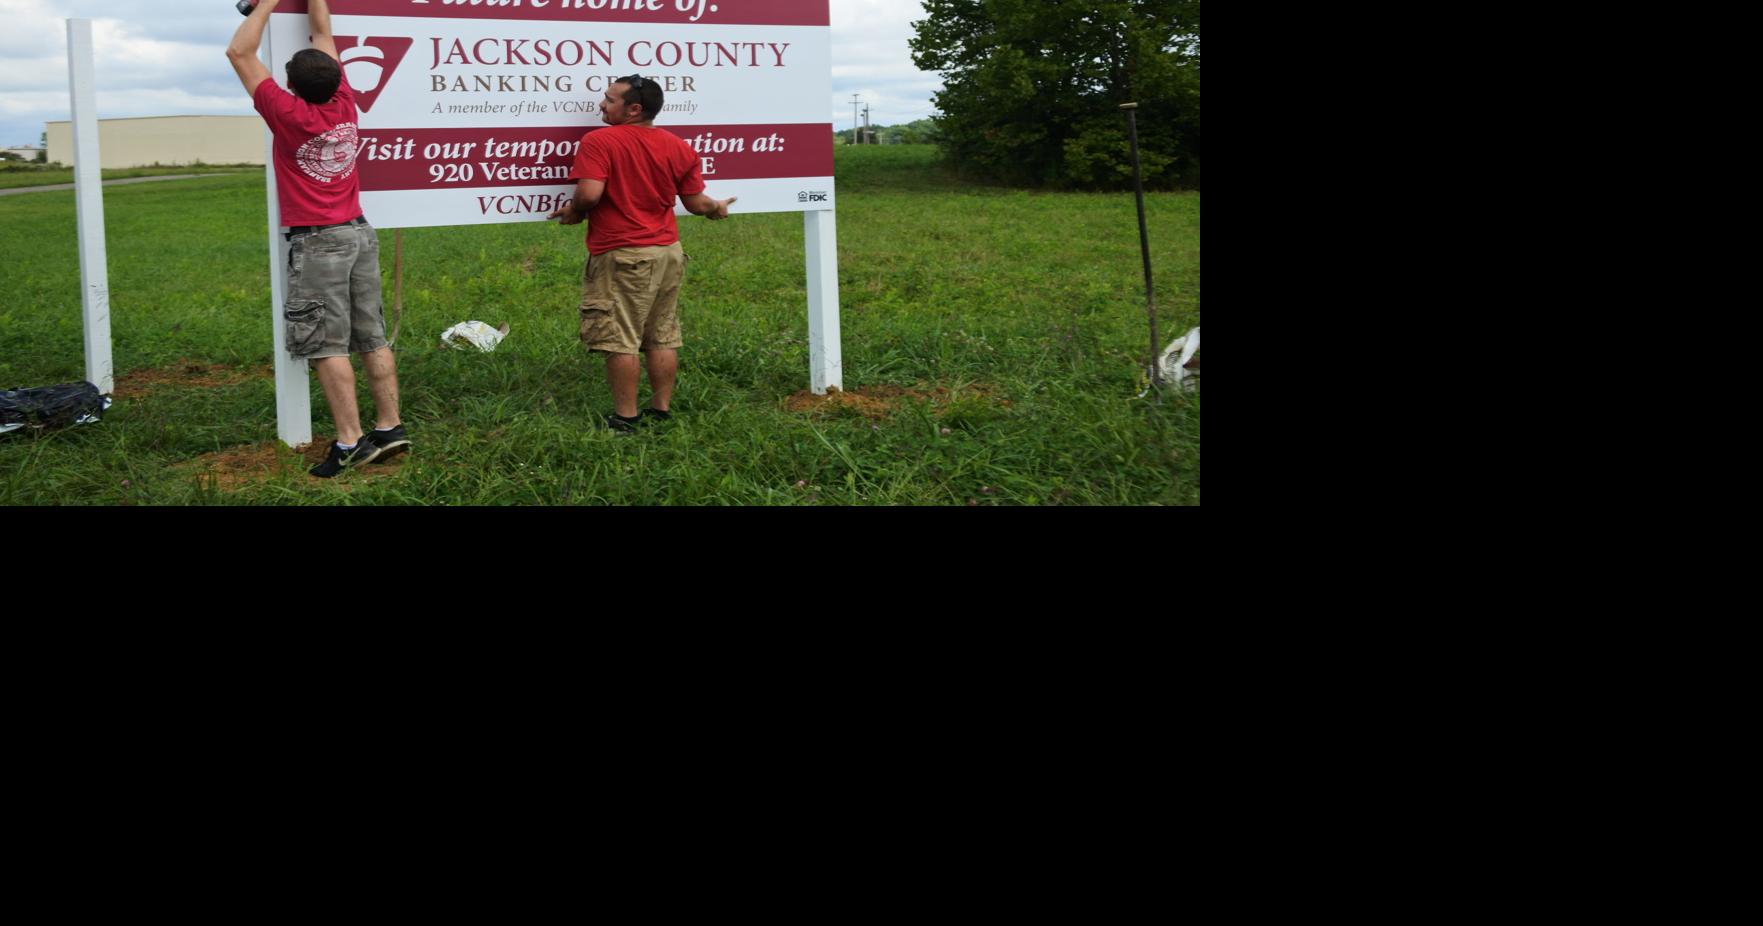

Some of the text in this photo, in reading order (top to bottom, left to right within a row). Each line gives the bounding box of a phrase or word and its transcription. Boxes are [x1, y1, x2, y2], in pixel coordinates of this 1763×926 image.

[430, 37, 790, 70] JACKSON COUNTY
[430, 74, 572, 92] BANKING
[432, 102, 442, 113] A
[448, 101, 505, 114] member
[510, 101, 526, 116] of
[527, 102, 547, 113] the
[553, 103, 594, 113] VCNB
[662, 100, 698, 115] amily
[423, 142, 476, 159] our
[752, 132, 785, 152] at:
[429, 163, 474, 182] 920
[479, 162, 574, 182] Veteran
[477, 192, 574, 215] VCNBf
